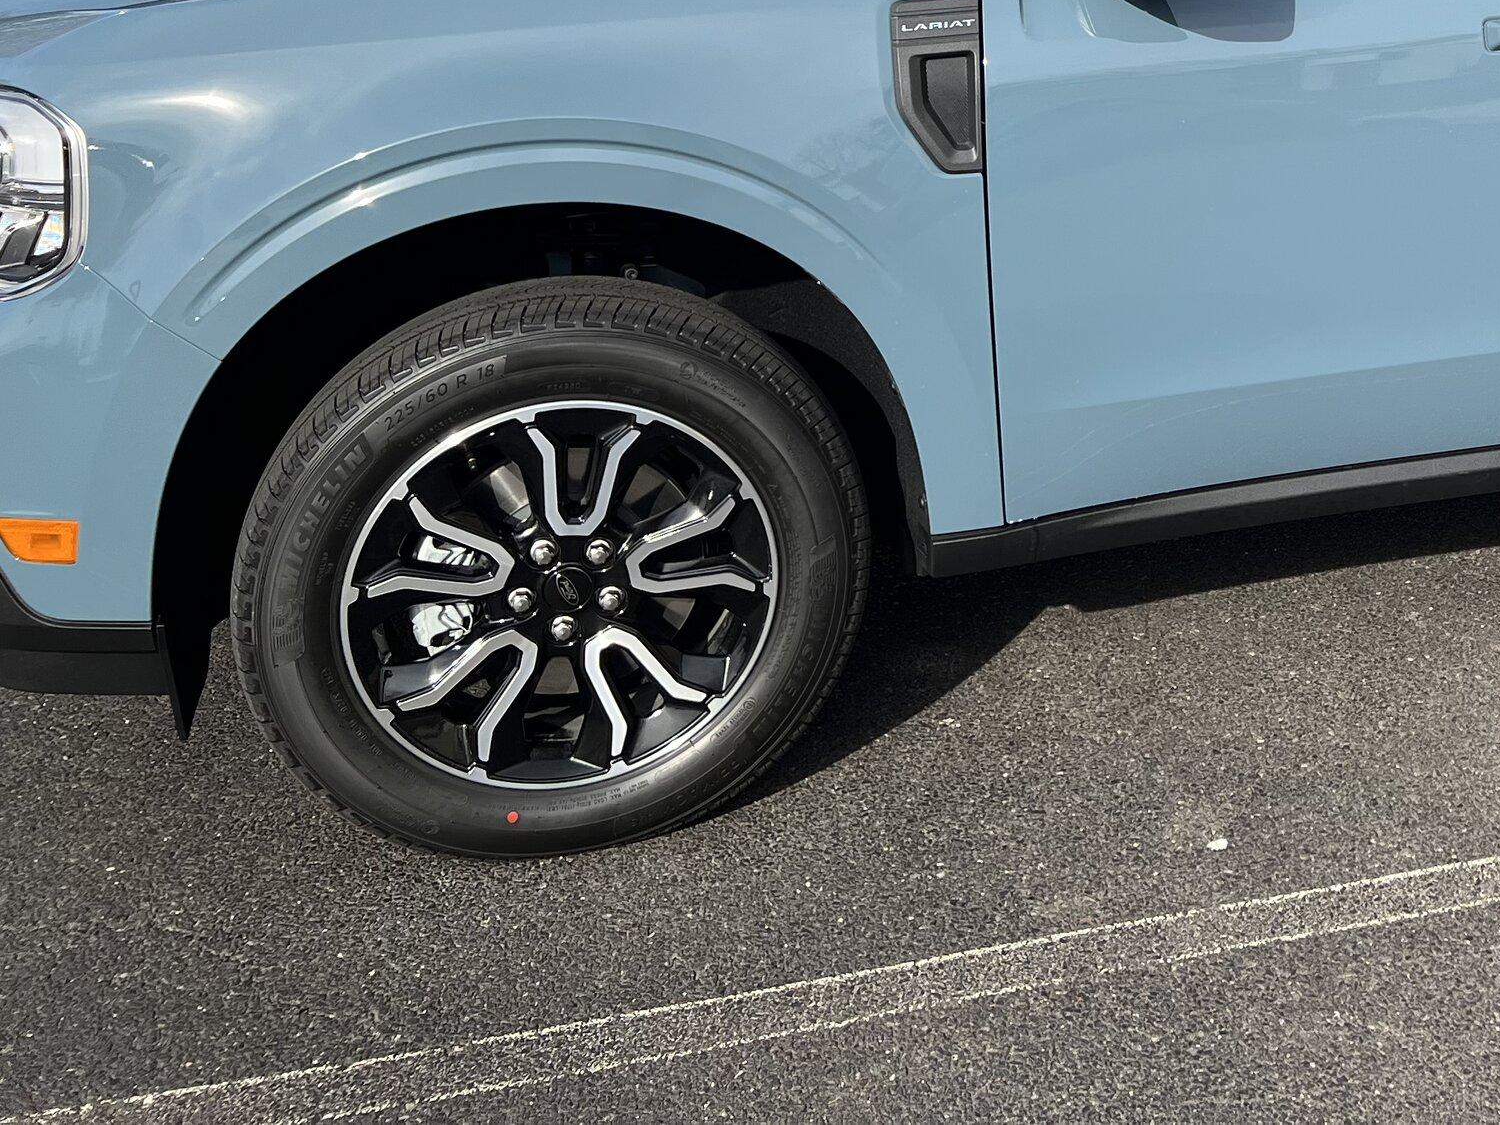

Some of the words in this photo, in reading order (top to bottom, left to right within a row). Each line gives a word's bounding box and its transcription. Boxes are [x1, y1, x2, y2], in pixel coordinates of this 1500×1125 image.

[901, 19, 976, 32] LARIAT
[384, 381, 449, 432] 225/60
[455, 373, 468, 390] R
[476, 363, 496, 382] 18
[282, 443, 368, 579] MICHELIN
